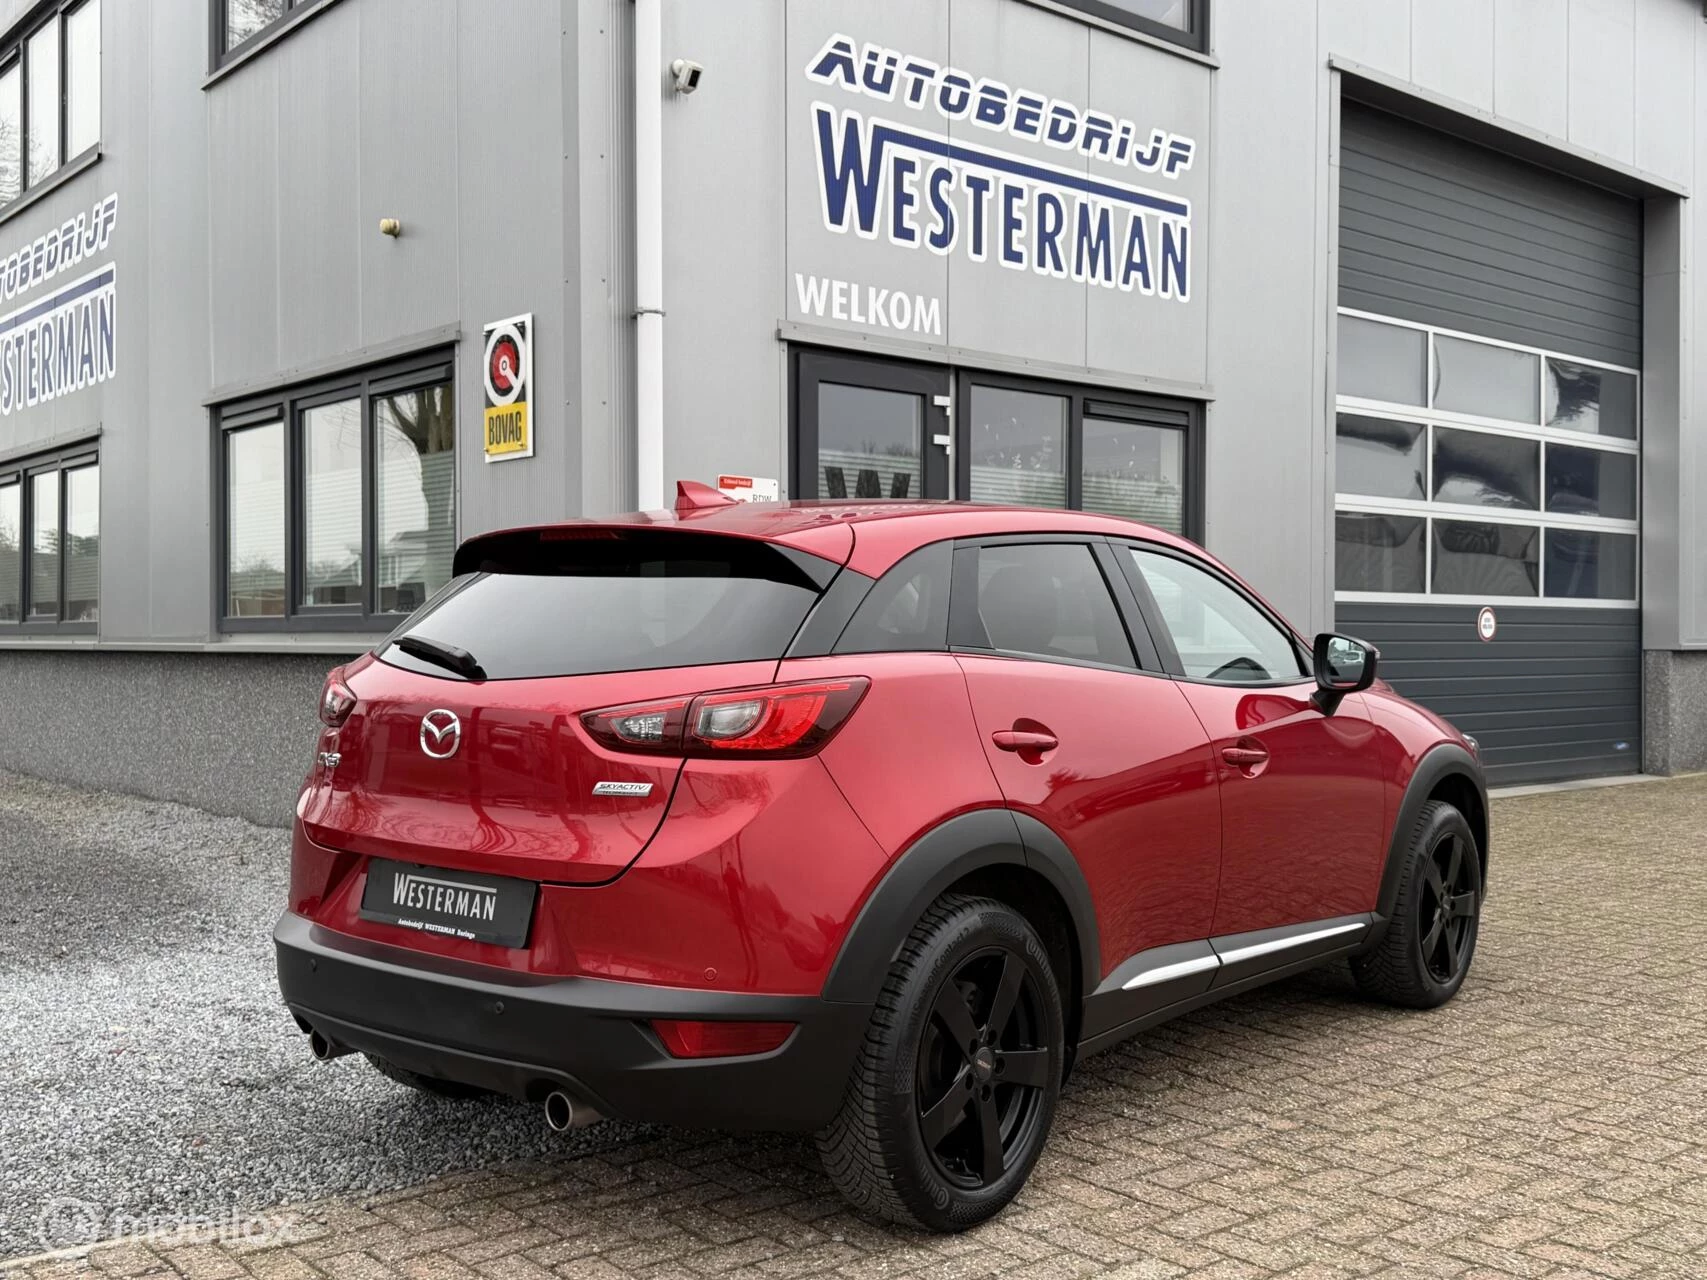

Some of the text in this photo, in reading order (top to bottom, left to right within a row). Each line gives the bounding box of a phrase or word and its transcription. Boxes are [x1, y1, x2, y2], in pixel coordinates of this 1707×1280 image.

[808, 36, 1194, 177] AUTOBEDRIJF
[812, 103, 1189, 300] WESTERMAN
[795, 272, 942, 335] WELKOM
[0, 289, 116, 413] STERMAN
[488, 410, 522, 446] BOVAG
[392, 872, 497, 921] WESTERMAN
[424, 922, 456, 935] WESTERMAN
